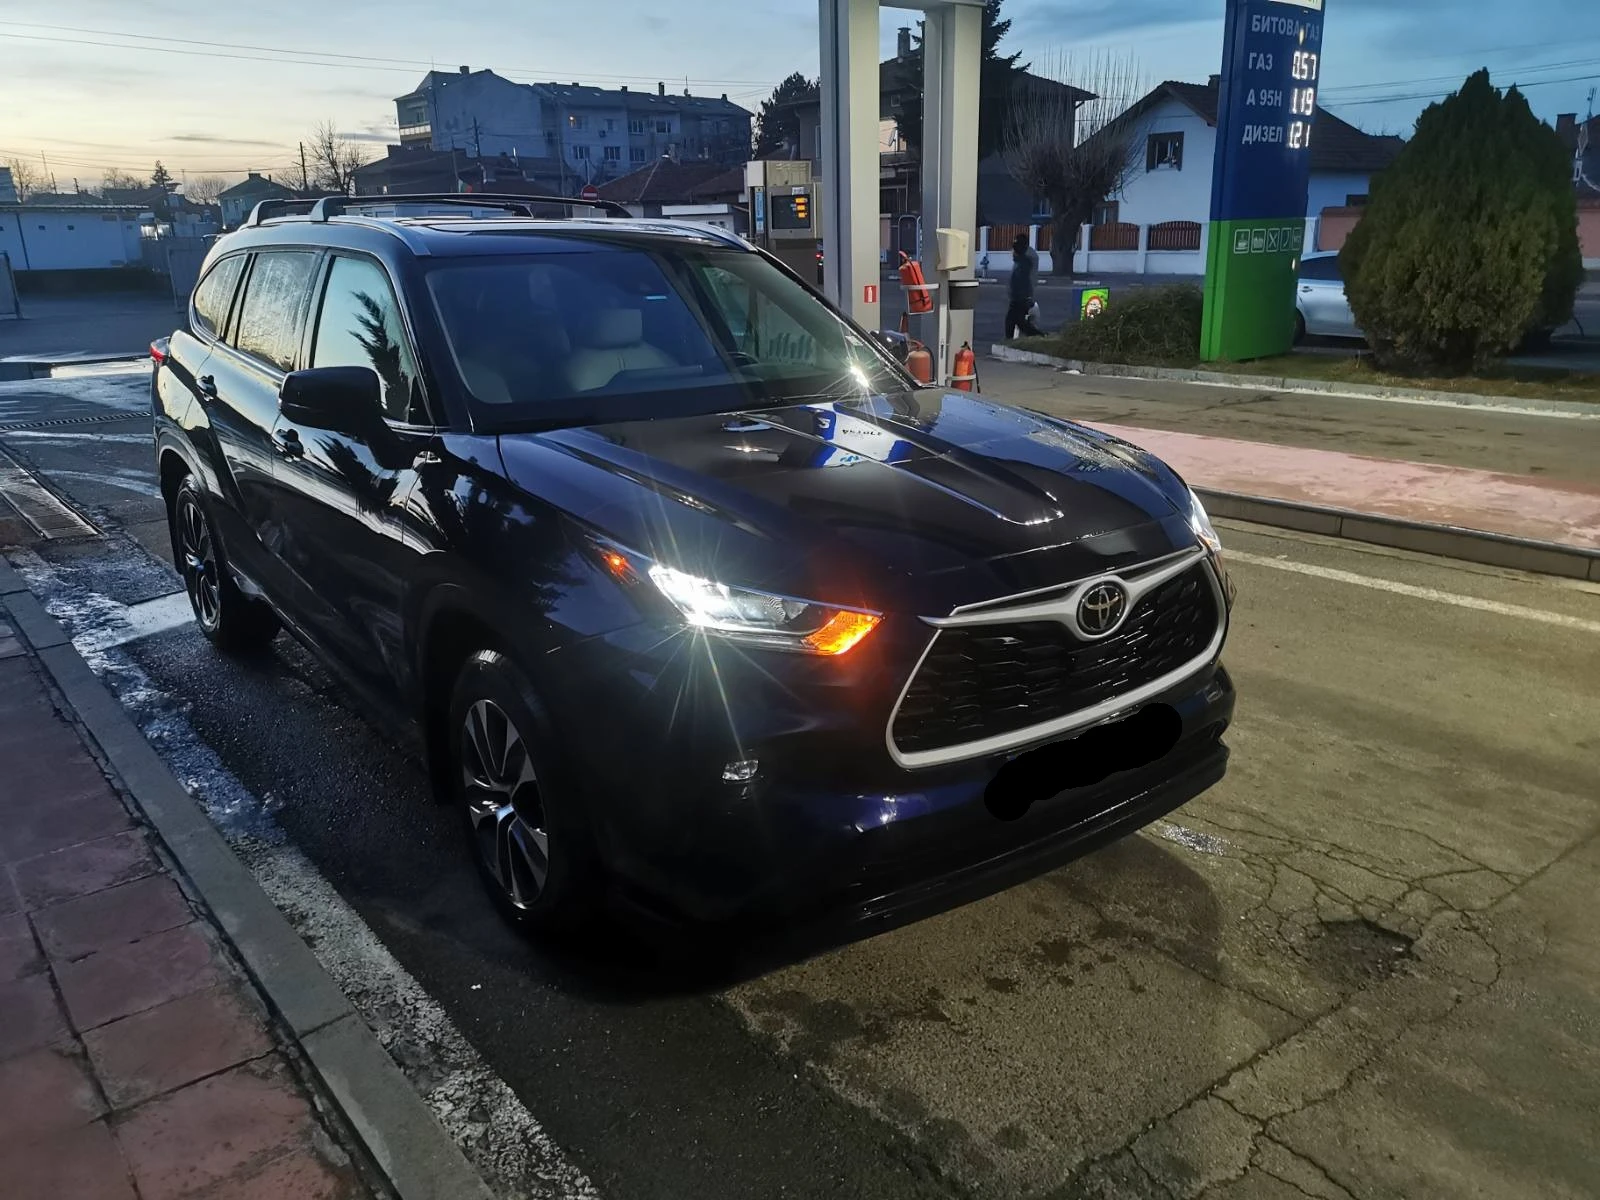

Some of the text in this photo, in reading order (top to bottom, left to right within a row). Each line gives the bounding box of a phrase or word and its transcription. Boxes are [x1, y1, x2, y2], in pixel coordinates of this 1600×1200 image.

[1252, 14, 1299, 37] БИТОВА
[1248, 52, 1273, 71] ГАЗ
[1246, 88, 1256, 106] А
[1260, 89, 1283, 107] 95Н
[1242, 124, 1283, 145] ДИЗЕЛ
